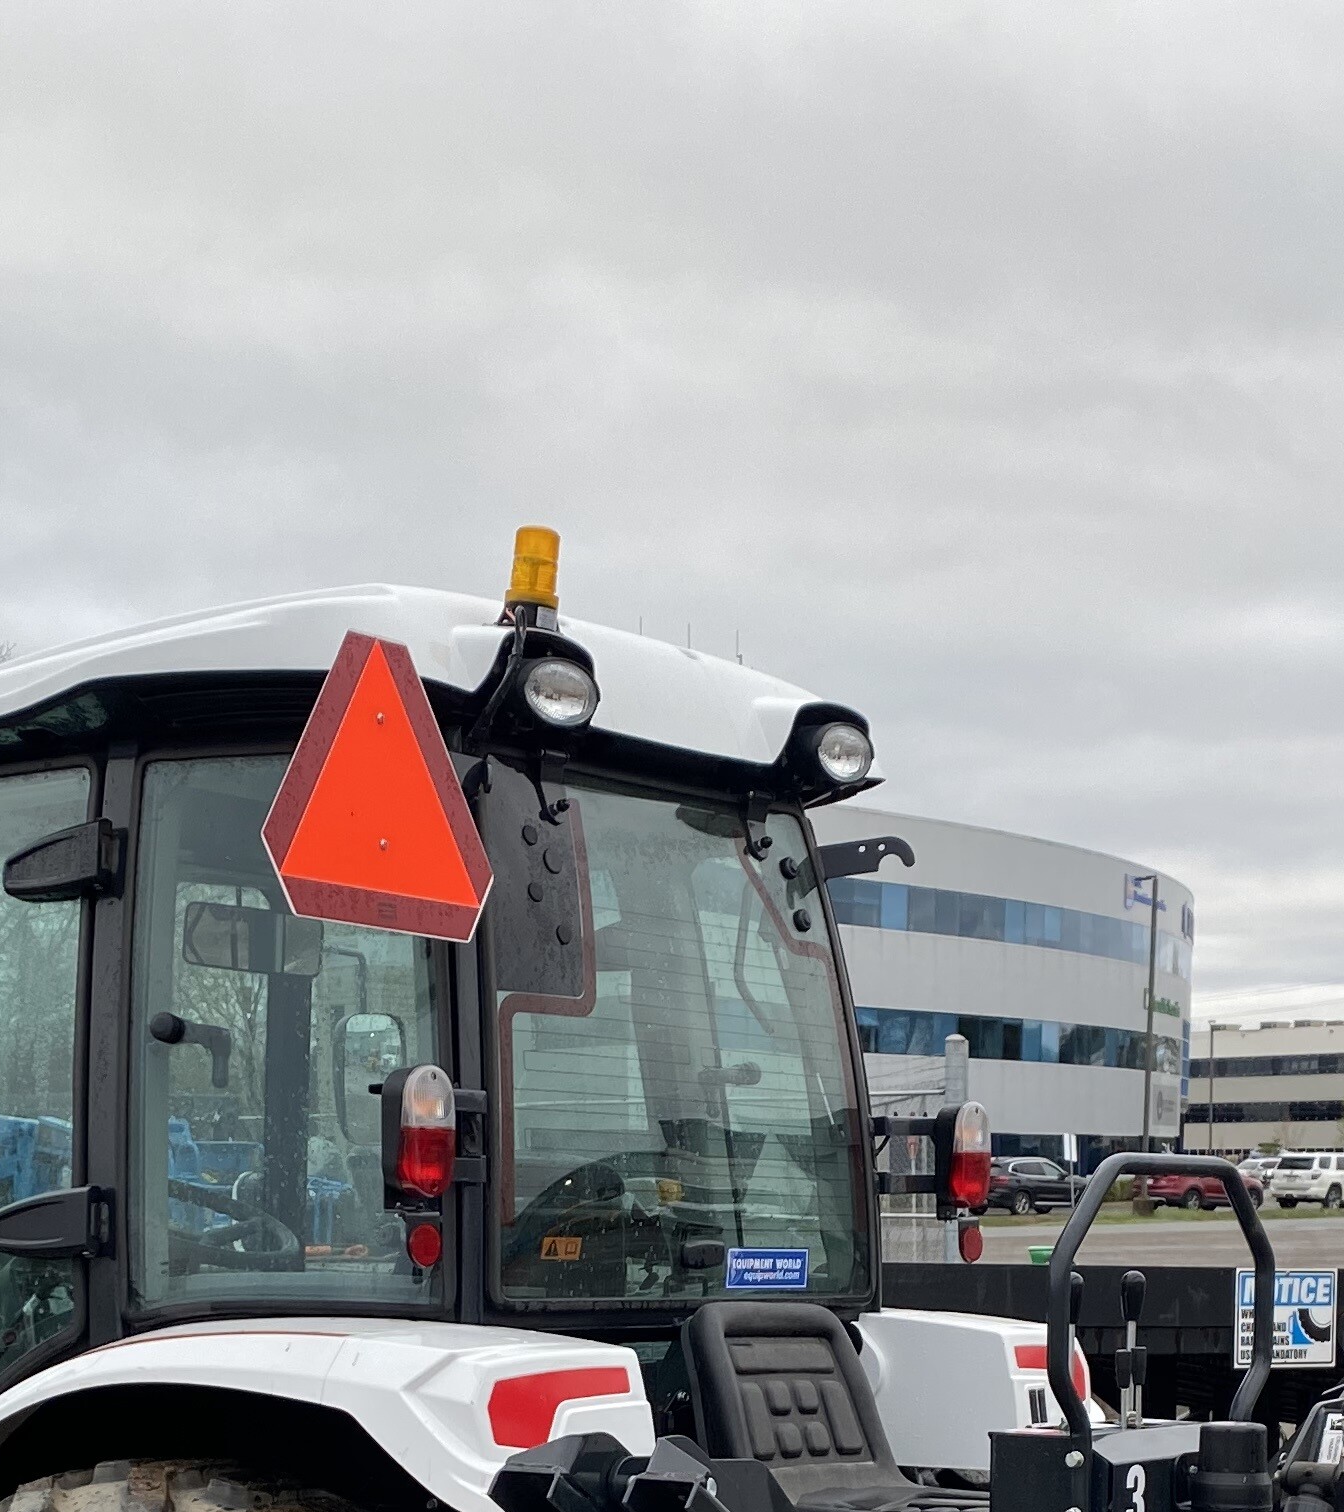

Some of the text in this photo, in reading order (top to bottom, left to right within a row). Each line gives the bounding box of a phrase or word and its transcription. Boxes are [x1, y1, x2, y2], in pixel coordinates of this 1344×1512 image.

[732, 1258, 802, 1270] EQUIPMENT WORLD
[743, 1269, 800, 1282] equipworld.com
[1243, 1277, 1331, 1304] NTICE
[1272, 1349, 1307, 1360] ANDATORY
